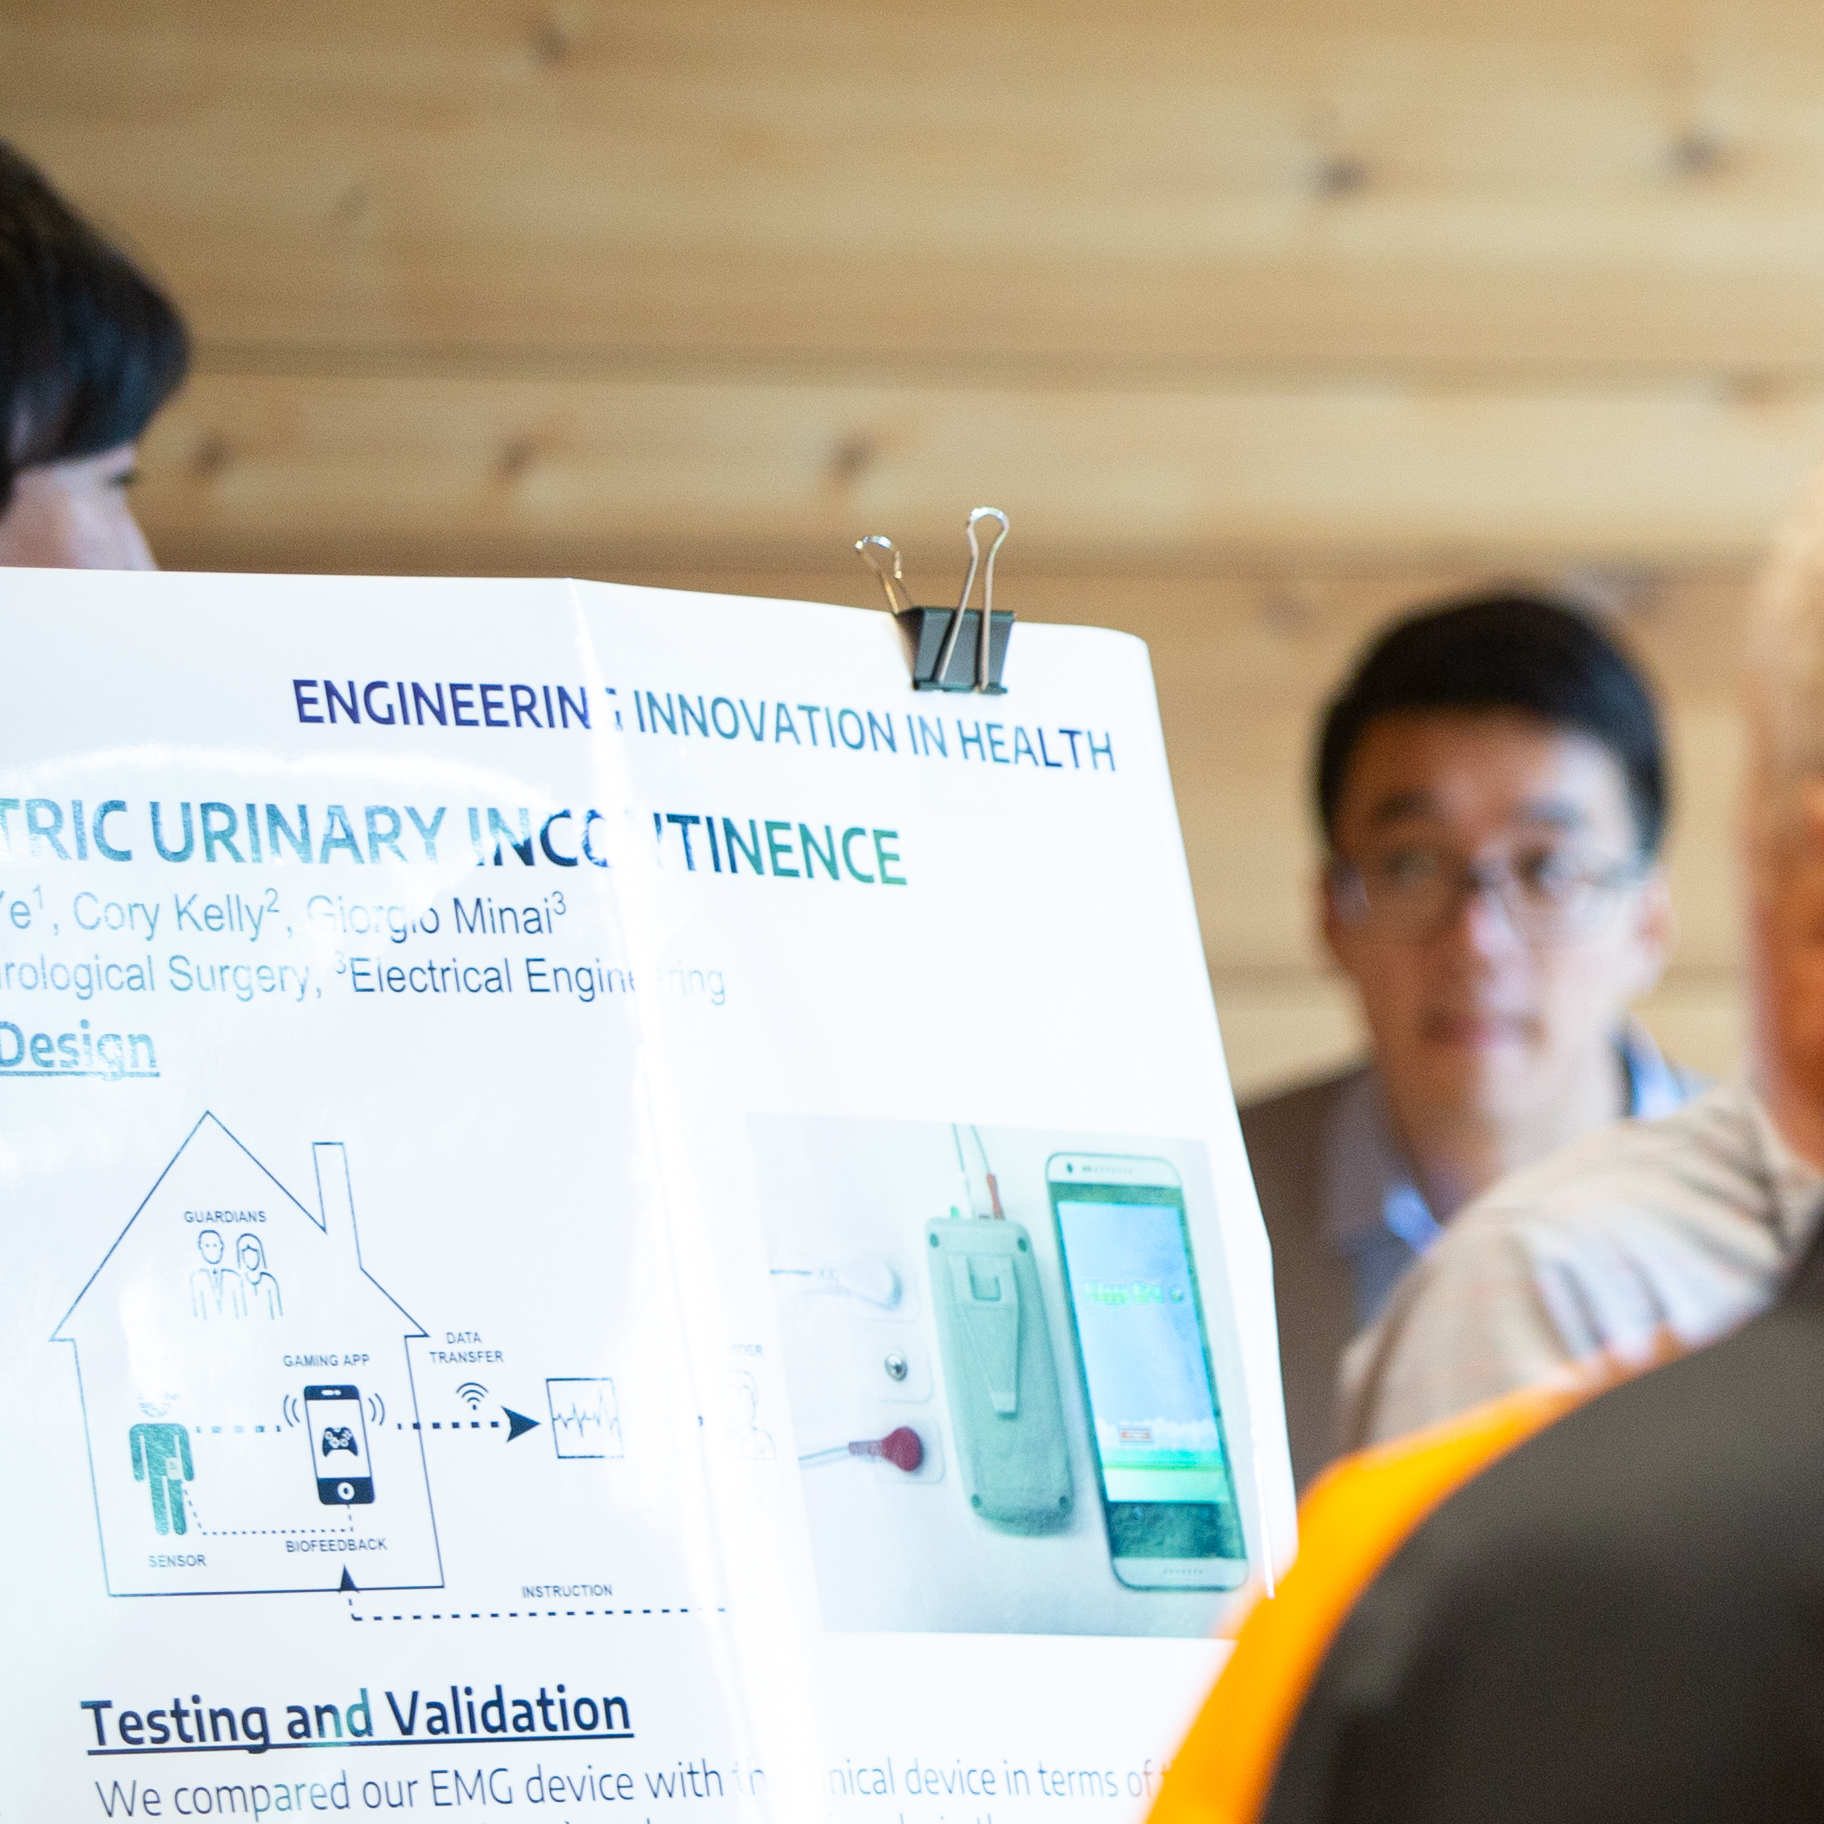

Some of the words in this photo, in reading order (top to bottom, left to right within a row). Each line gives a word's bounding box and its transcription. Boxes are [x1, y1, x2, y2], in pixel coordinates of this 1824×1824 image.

[634, 689, 898, 754] INNOVATION
[906, 714, 949, 758] IN
[957, 719, 1116, 772] HEALTH
[150, 801, 448, 866] URINARY
[467, 806, 908, 887] INCOTINENCE
[73, 891, 160, 941] Cory
[0, 954, 154, 1001] rological
[169, 955, 323, 1002] Surgery,
[0, 1019, 157, 1080] Design
[184, 1210, 267, 1224] GUARDIANS
[445, 1331, 482, 1345] DATA
[283, 1354, 339, 1368] GAMING
[343, 1353, 370, 1367] APP
[429, 1350, 505, 1364] TRANSFER
[286, 1537, 388, 1553] BIOFEEDBACK
[149, 1554, 207, 1569] SENSOR
[521, 1584, 614, 1599] INSTRUCTION
[81, 1694, 272, 1754] Testing
[286, 1688, 373, 1740] and
[386, 1684, 632, 1737] Validation
[95, 1779, 161, 1819] We
[174, 1770, 352, 1822] compared
[362, 1776, 419, 1809] our
[431, 1767, 513, 1808] EMG
[526, 1764, 634, 1804] device
[644, 1757, 724, 1799] with
[905, 1757, 997, 1797] device
[1004, 1760, 1030, 1796] in
[1037, 1762, 1119, 1799] terms
[1126, 1759, 1153, 1797] of
